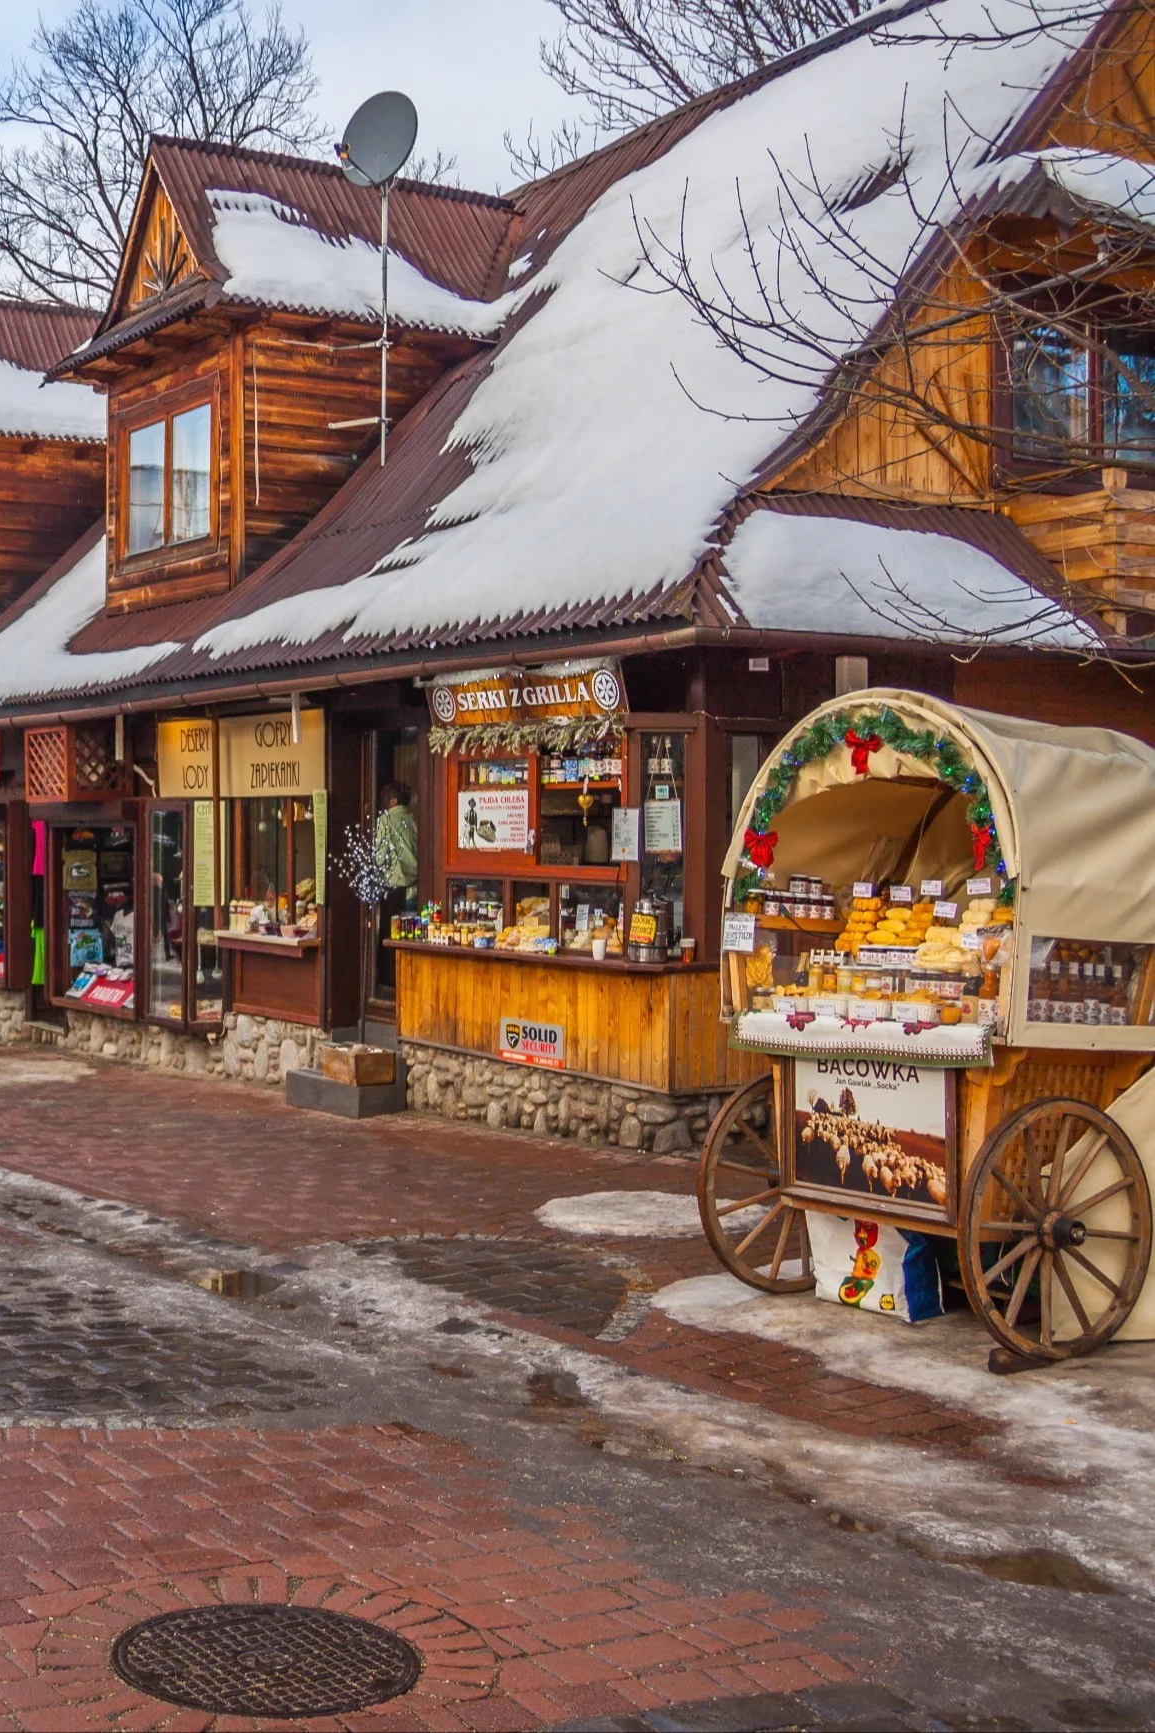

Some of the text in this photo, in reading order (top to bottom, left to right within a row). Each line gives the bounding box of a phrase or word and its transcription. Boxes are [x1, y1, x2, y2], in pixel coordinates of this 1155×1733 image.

[457, 682, 591, 711] SERKI Z GRILLA
[180, 720, 292, 753] DESERY GOFRY
[182, 761, 300, 789] LODY ZAPIEKANKI
[522, 1026, 558, 1044] SOLID
[522, 1040, 557, 1054] SECURITY
[835, 1077, 847, 1085] Jan
[847, 1079, 872, 1088] Gawlak
